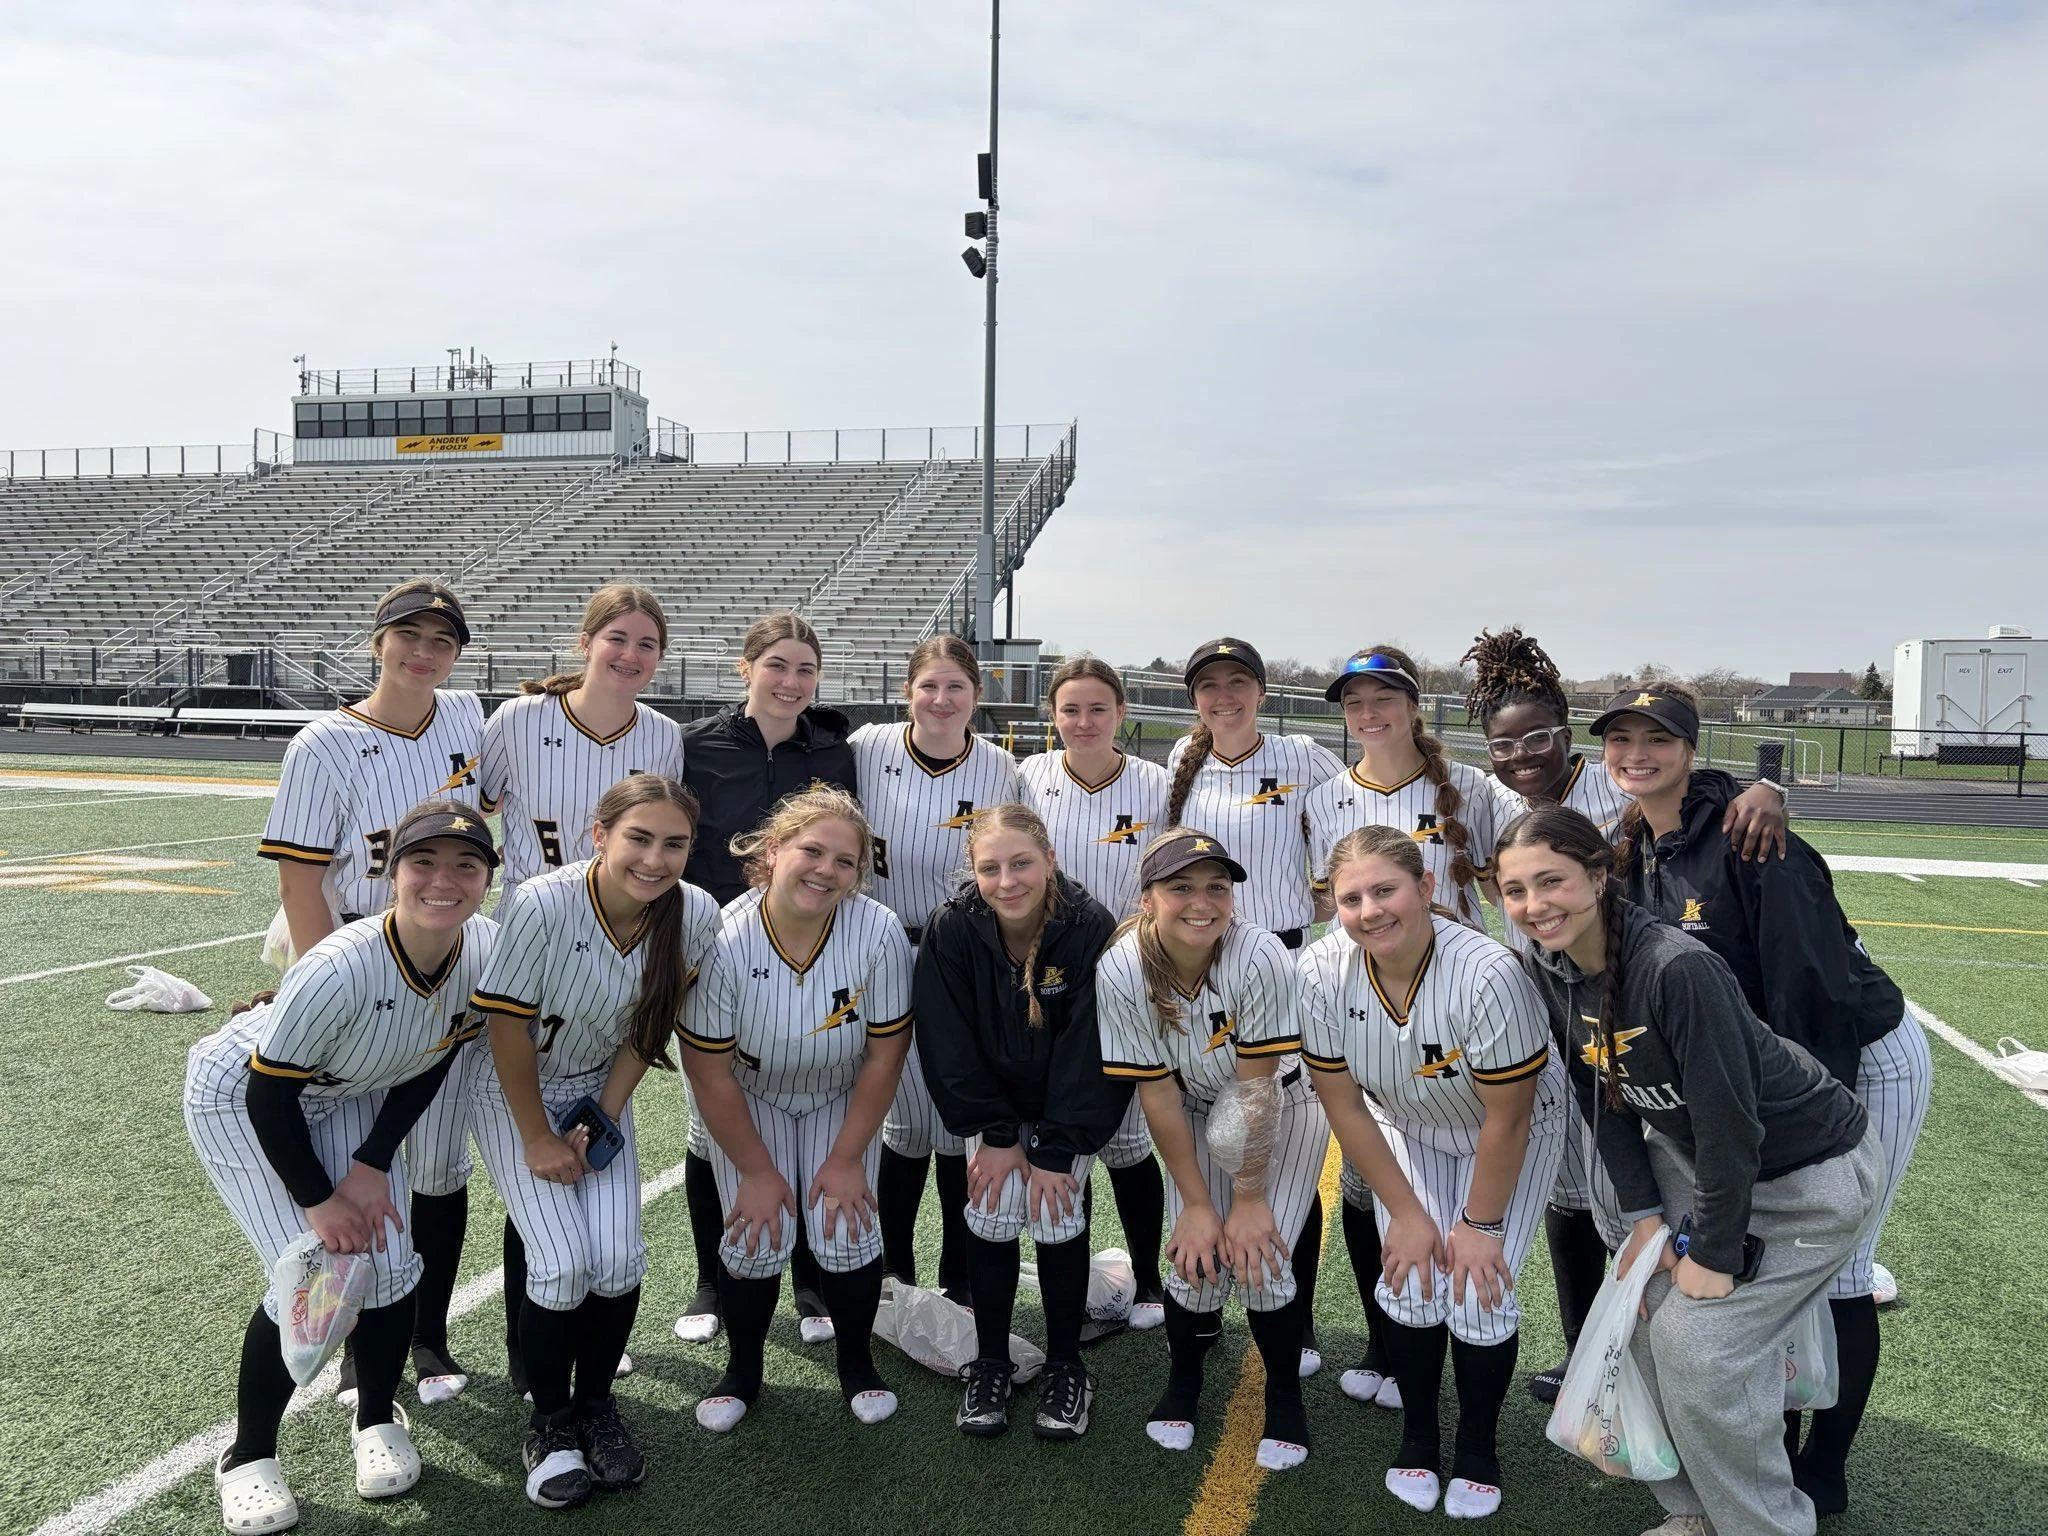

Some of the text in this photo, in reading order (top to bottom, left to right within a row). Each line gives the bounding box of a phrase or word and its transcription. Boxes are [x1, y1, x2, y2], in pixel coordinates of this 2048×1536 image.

[532, 820, 563, 867] 6
[1681, 922, 1710, 930] SOFTBALL
[1040, 982, 1069, 995] SOFTBALL
[536, 1015, 566, 1054] 7
[1111, 1289, 1124, 1304] for
[422, 1376, 453, 1385] TCK
[859, 1391, 886, 1399] TCK
[704, 1397, 732, 1405] TCK
[1274, 1441, 1302, 1452] TCK
[1397, 1469, 1429, 1478] TCK
[1465, 1481, 1499, 1494] TCK
